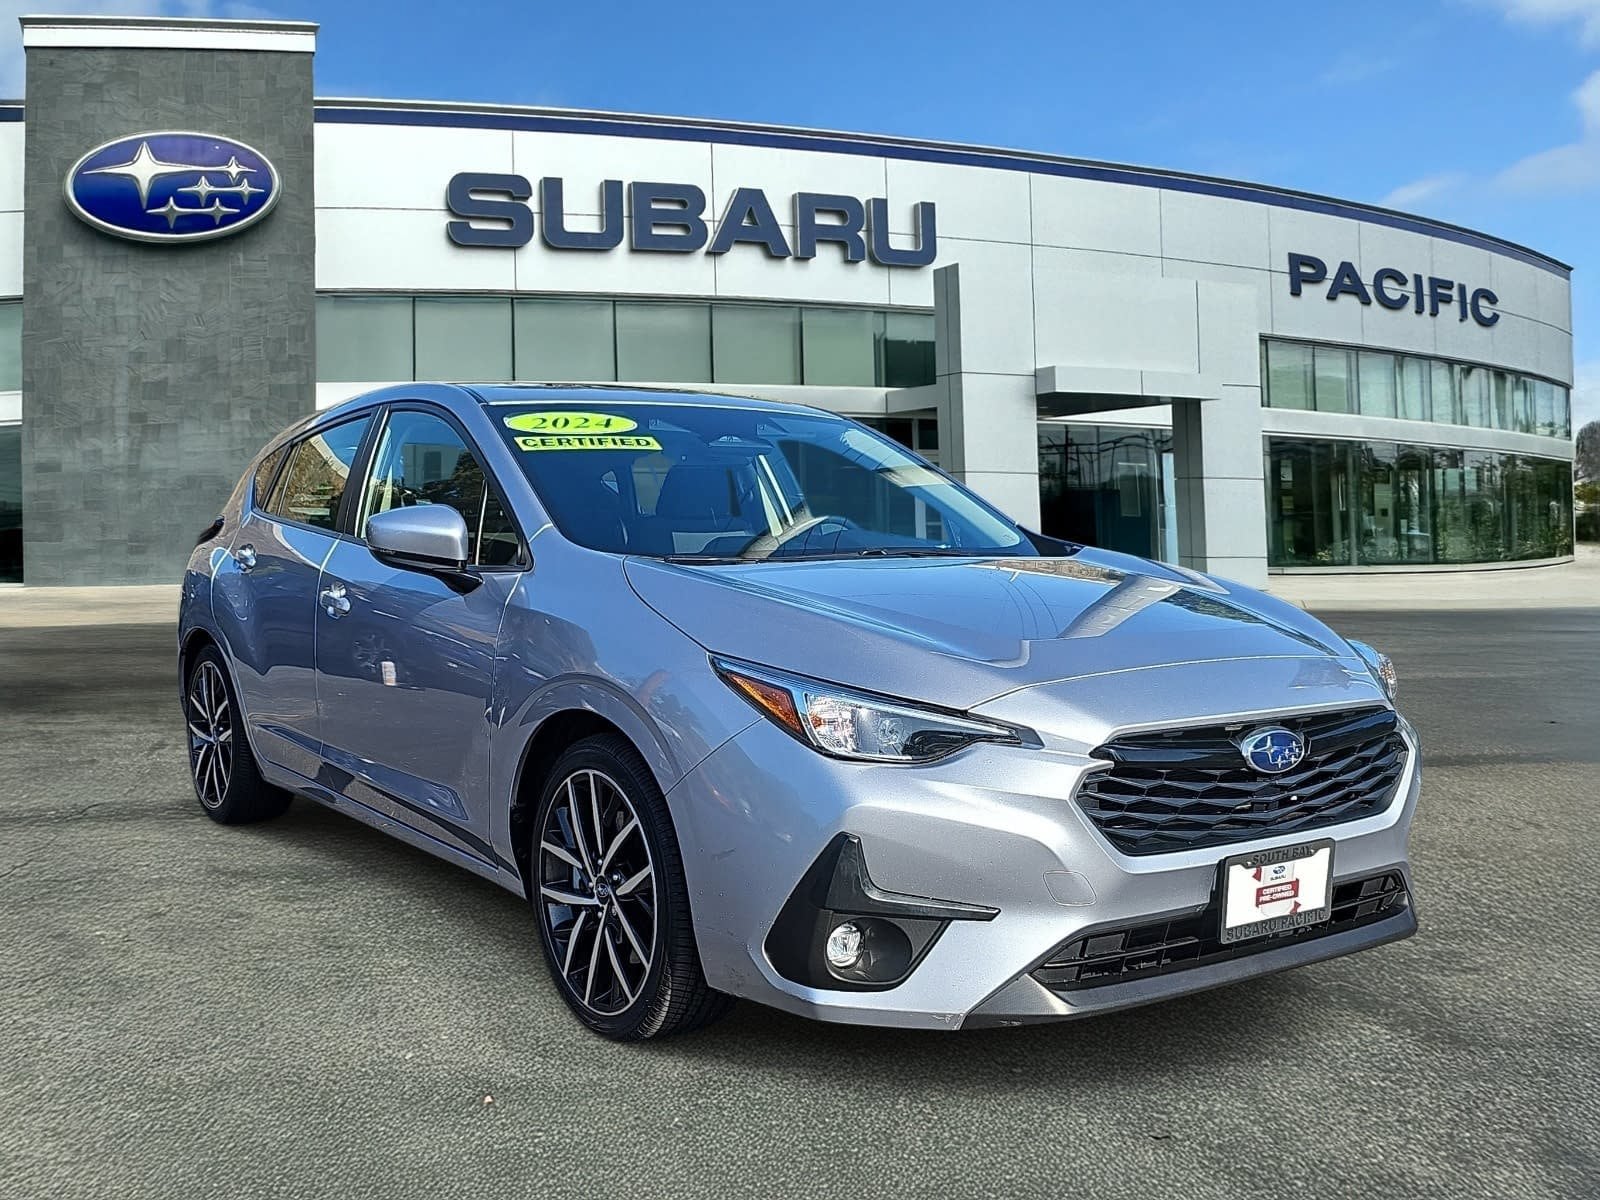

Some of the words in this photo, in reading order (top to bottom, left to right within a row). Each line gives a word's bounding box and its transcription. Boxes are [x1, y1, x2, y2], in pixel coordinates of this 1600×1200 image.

[447, 172, 937, 267] SUBARU
[1287, 252, 1500, 327] PACIFIC
[531, 417, 612, 429] 2024
[522, 437, 651, 447] CERTIFIED
[1252, 849, 1289, 865] SOUTH
[1259, 890, 1295, 903] PRE-OWNED
[1262, 884, 1293, 895] CERTIFIED
[1226, 920, 1277, 941] SUBARU
[1281, 909, 1328, 929] PACIFIC
